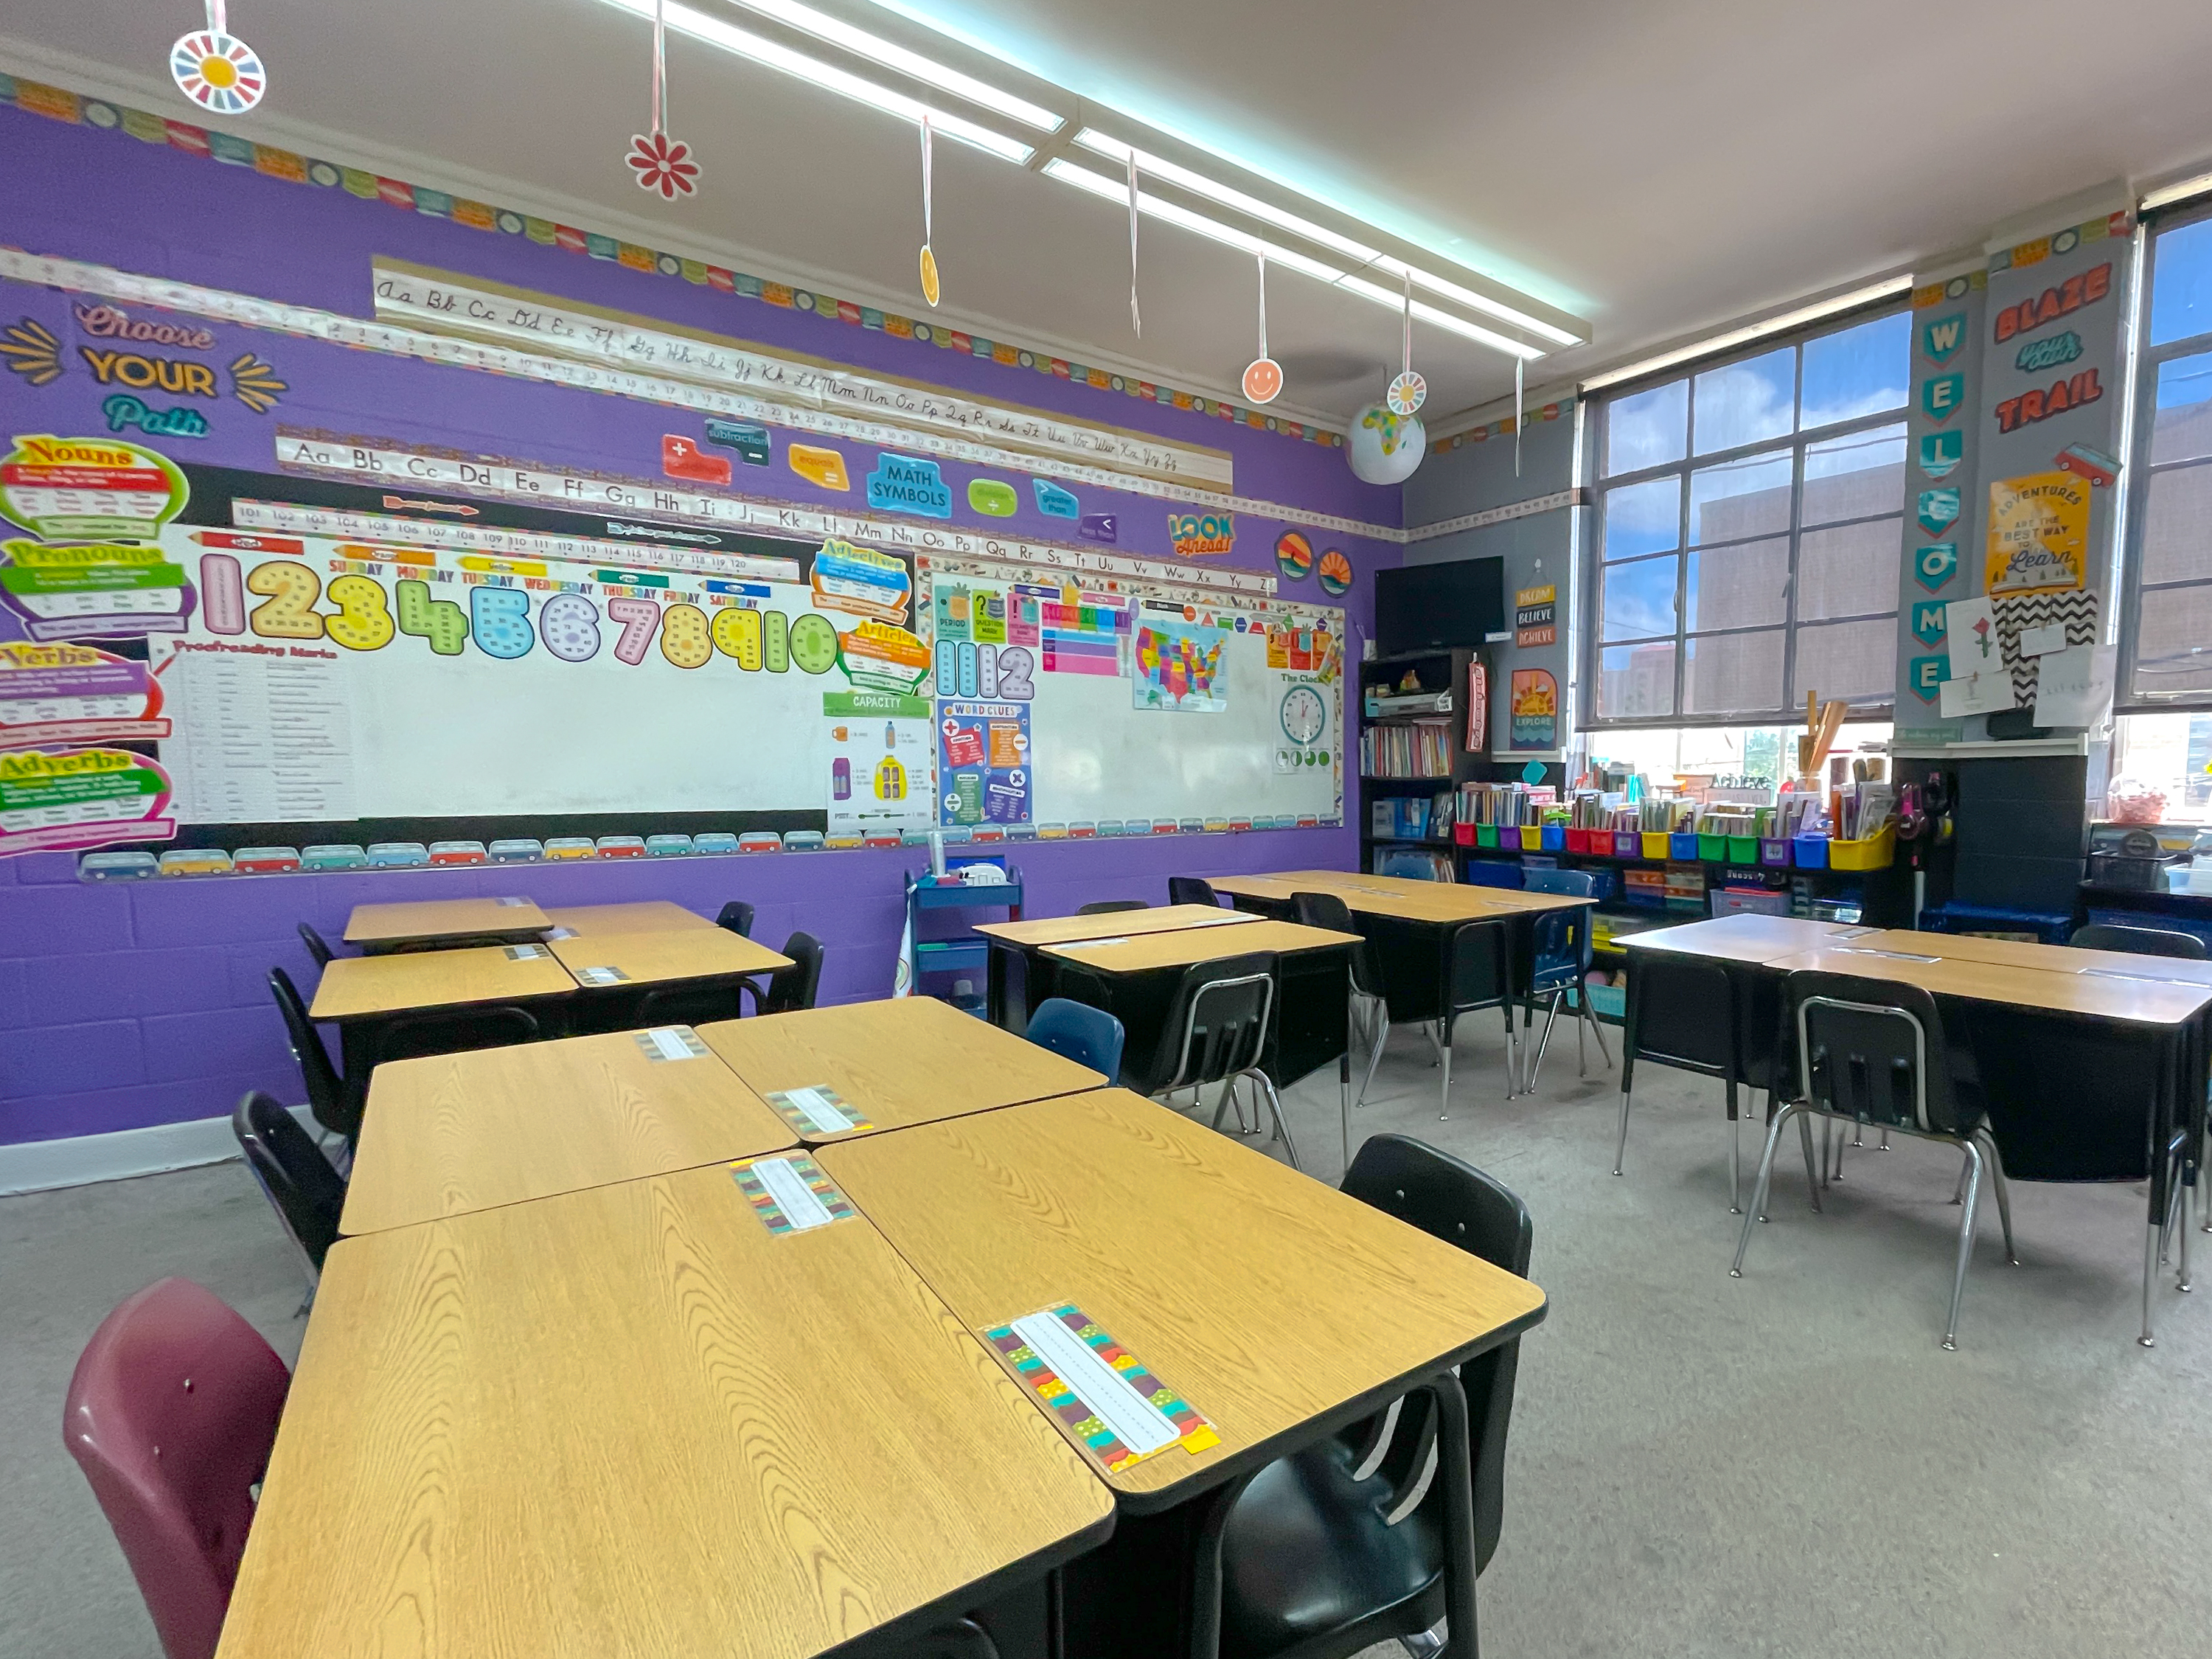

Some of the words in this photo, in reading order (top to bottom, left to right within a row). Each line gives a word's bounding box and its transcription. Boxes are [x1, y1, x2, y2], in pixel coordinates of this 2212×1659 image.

[1994, 262, 2112, 344] BLAZE
[75, 303, 215, 349] Choose
[378, 281, 414, 302] Aa
[427, 290, 457, 312] Bb
[469, 300, 495, 321] Cc
[507, 310, 541, 331] Dd
[551, 318, 574, 338] Ee
[585, 326, 613, 352] Ff
[628, 335, 655, 360] Gg
[666, 342, 692, 364] Hh
[700, 352, 726, 371] Ii
[734, 358, 751, 381] Jj
[761, 364, 786, 384] Kk
[794, 373, 816, 390] Ll
[81, 349, 216, 396] YOUR
[1995, 367, 2103, 434] TRAIL
[103, 394, 208, 437] Path
[821, 376, 856, 398] Mm
[863, 386, 889, 406] Nn
[895, 394, 915, 411] Oo
[922, 399, 938, 418] Pp
[973, 410, 992, 428] Rr
[1047, 427, 1066, 443] Uu
[1072, 432, 1090, 448] Vv
[1094, 437, 1116, 453] Ww
[1120, 443, 1138, 459] Xx
[1143, 448, 1160, 468] Yy
[709, 428, 768, 446] subtraction
[24, 441, 133, 466] Nouns
[888, 465, 932, 486] MATH
[874, 481, 946, 507] SYMBOLS
[1043, 493, 1072, 507] greater
[1998, 485, 2082, 516] ADVENTURES
[295, 443, 330, 464] Aa
[353, 449, 383, 471] Bb
[407, 458, 438, 478] Cc
[460, 464, 490, 486] Dd
[516, 472, 540, 492] Ee
[565, 479, 583, 497] Ff
[606, 486, 636, 507] Gg
[655, 492, 678, 511] Hh
[700, 499, 715, 515] Ii
[740, 505, 754, 524] Jj
[779, 510, 800, 528] Kk
[824, 516, 837, 532] Ll
[855, 523, 881, 539] Mm
[892, 527, 912, 543] Nn
[923, 532, 945, 547] Oo
[956, 536, 970, 552] Pp
[987, 541, 1006, 557] Qq
[1020, 546, 1033, 559] Rr
[1048, 550, 1061, 564] Ss
[1074, 553, 1085, 567] Tt
[1099, 557, 1113, 571] Uu
[1134, 563, 1147, 574] Vv
[1164, 566, 1185, 579] Ww
[1197, 571, 1211, 583] Xx
[1230, 574, 1242, 588] Yy
[1048, 504, 1066, 515] than
[1170, 515, 1234, 541] LOOK
[2015, 519, 2034, 529] ARE
[2040, 515, 2059, 526] THE
[240, 507, 260, 518] 101
[273, 511, 294, 521] 102
[305, 514, 327, 525] 103
[336, 518, 358, 529] 104
[368, 521, 389, 532] 105
[397, 524, 419, 535] 106
[427, 527, 447, 538] 107
[456, 530, 475, 540] 108
[483, 533, 503, 543] 109
[510, 537, 526, 547] 110
[535, 539, 549, 549] 111
[558, 542, 573, 552] 112
[582, 545, 597, 554] 113
[605, 547, 620, 556] 114
[627, 549, 642, 558] 115
[649, 552, 664, 560] 116
[670, 554, 684, 563] 117
[692, 555, 706, 564] 118
[712, 557, 726, 566] 119
[731, 560, 746, 568] 120
[2004, 528, 2039, 542] BEST
[2043, 525, 2070, 536] WAY
[13, 542, 161, 563] Pronouns
[2006, 550, 2073, 573] Learn
[330, 560, 383, 576] SUNDAY
[397, 566, 453, 582] MONDAY
[462, 571, 514, 588] TUESDAY
[524, 578, 593, 594] WEDNESDAY
[602, 584, 656, 599] THURSDAY
[664, 590, 700, 604] FRIDAY
[1520, 588, 1551, 604] DREAM
[709, 595, 758, 609] SATURDAY
[200, 554, 246, 635] 1
[246, 560, 324, 639] 2
[324, 574, 395, 651] 3
[395, 580, 469, 655] 4
[470, 587, 535, 659] 5
[540, 594, 601, 663] 6
[608, 597, 661, 665] 7
[660, 604, 713, 669] 8
[711, 607, 763, 672] 9
[763, 611, 838, 675] 10
[940, 618, 965, 627] PERIOD
[1518, 608, 1551, 625] BELIEVE
[859, 621, 917, 642] Articles
[1519, 631, 1552, 646] ACHIEVE
[2, 646, 93, 666] Verbs
[173, 640, 285, 657] Proofreading
[290, 646, 338, 659] Marks
[1281, 673, 1297, 682] The
[853, 696, 901, 708] CAPACITY
[956, 705, 984, 715] WORD
[987, 706, 1015, 716] CLUES
[1517, 717, 1551, 726] EXPLORE
[1, 752, 131, 773] Adverbs
[1709, 773, 1770, 790] Achieve
